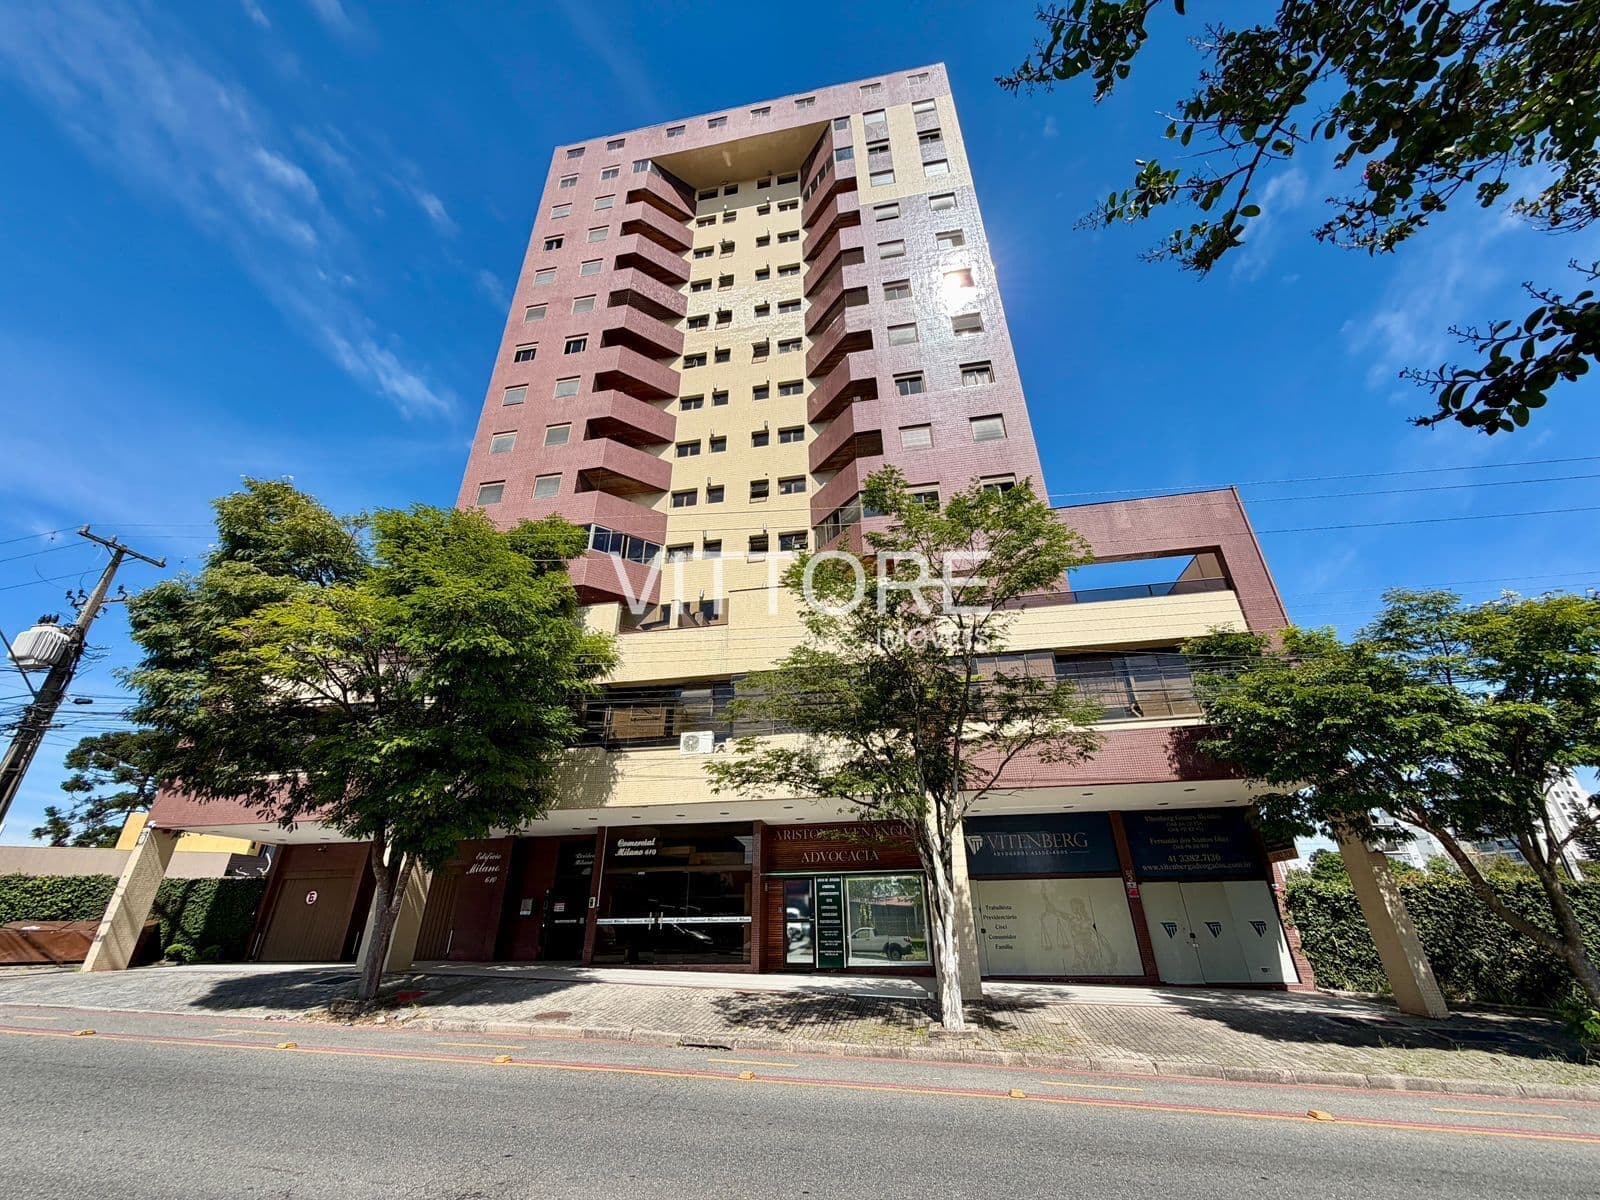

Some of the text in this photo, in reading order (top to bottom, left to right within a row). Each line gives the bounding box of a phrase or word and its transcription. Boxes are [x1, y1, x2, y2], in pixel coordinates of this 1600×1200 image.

[775, 828, 832, 841] ARISTO
[987, 832, 1088, 849] VITENBERG
[617, 837, 656, 847] Comercial
[615, 848, 643, 857] Milano
[801, 850, 880, 863] ADVOCACIA
[466, 862, 500, 875] Milano
